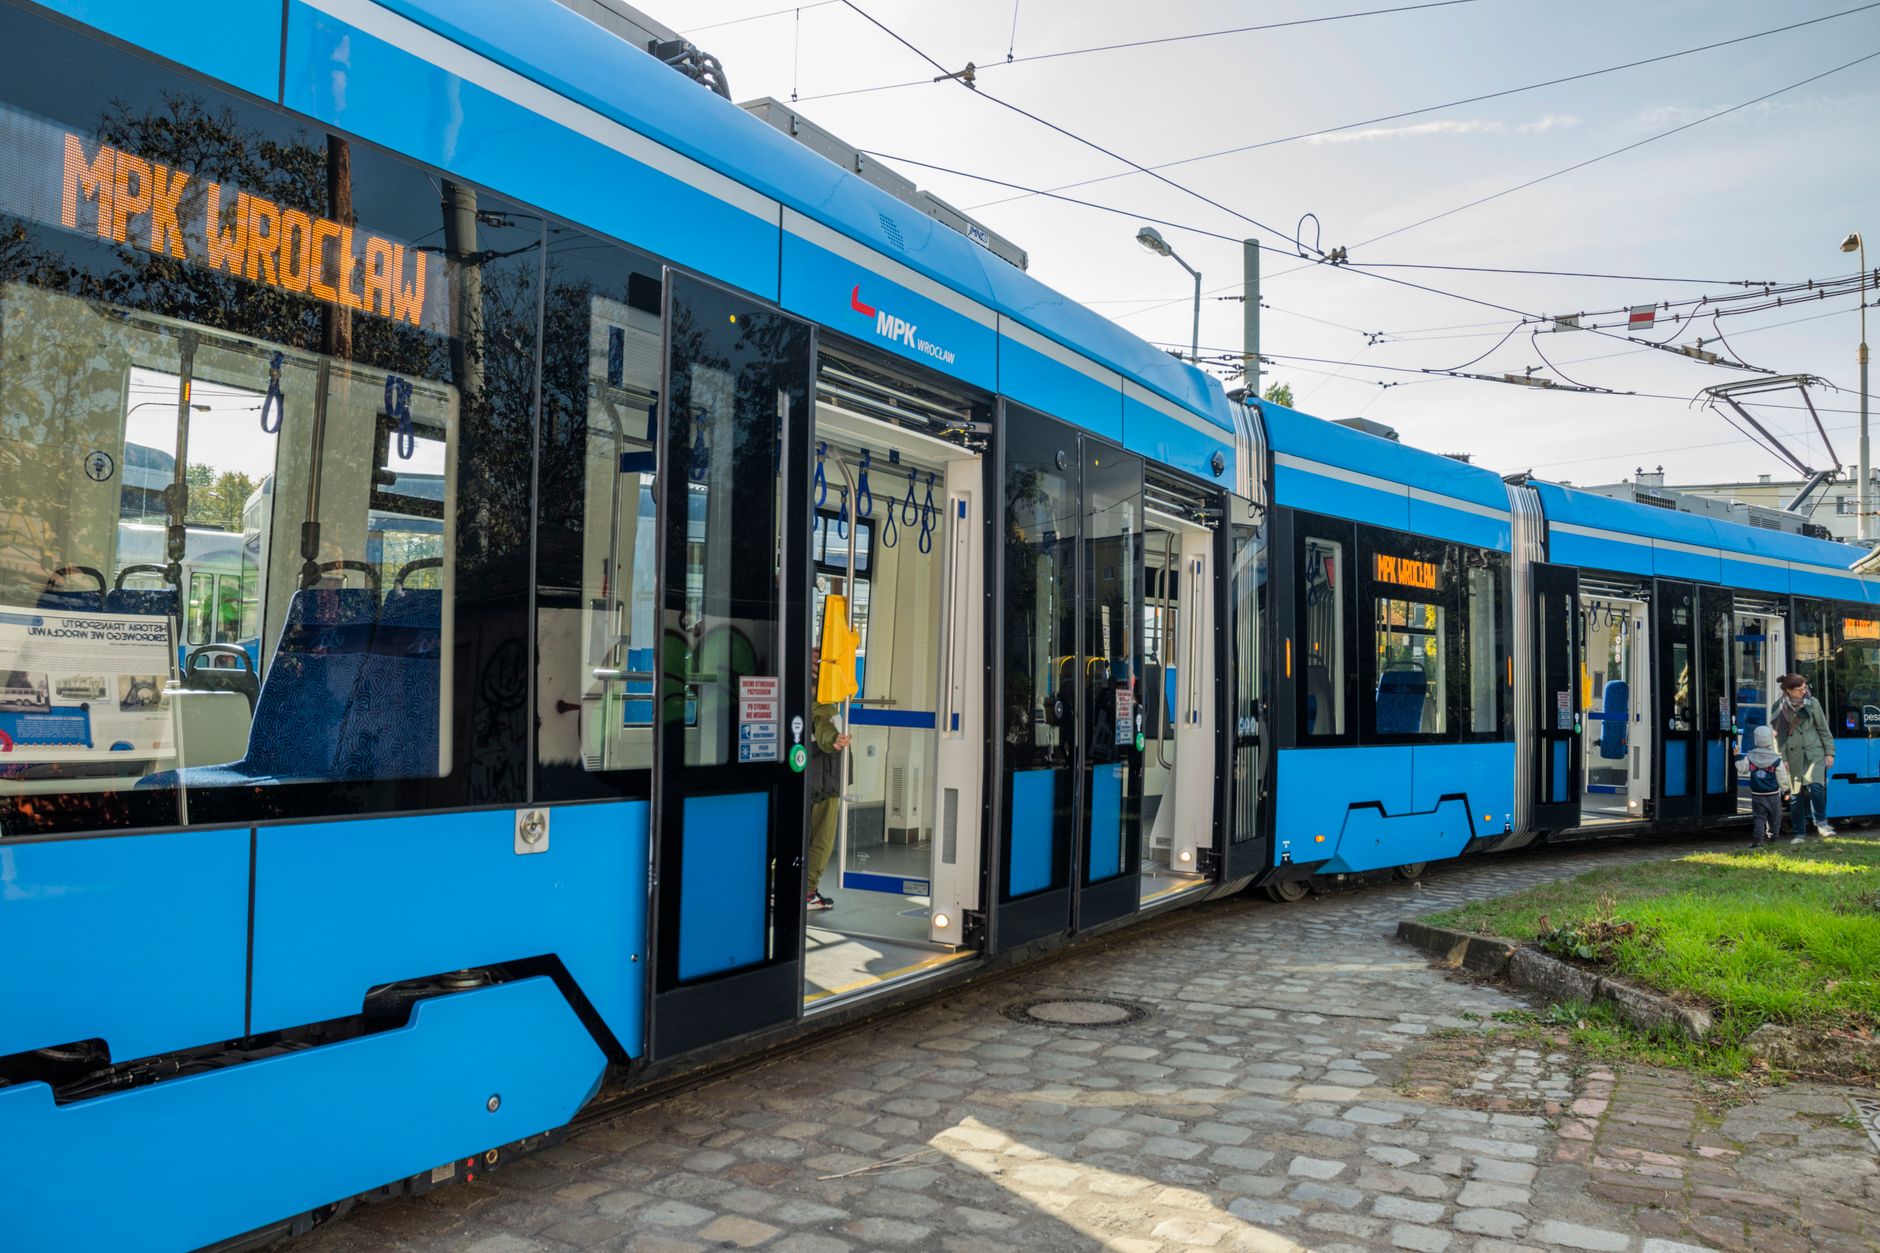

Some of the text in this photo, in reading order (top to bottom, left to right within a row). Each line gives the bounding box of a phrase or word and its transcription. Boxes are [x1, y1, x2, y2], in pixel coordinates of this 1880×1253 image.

[62, 132, 426, 327] MPK WROCŁAW
[876, 310, 955, 364] MPK WROCŁAW
[1378, 554, 1397, 583] MPK
